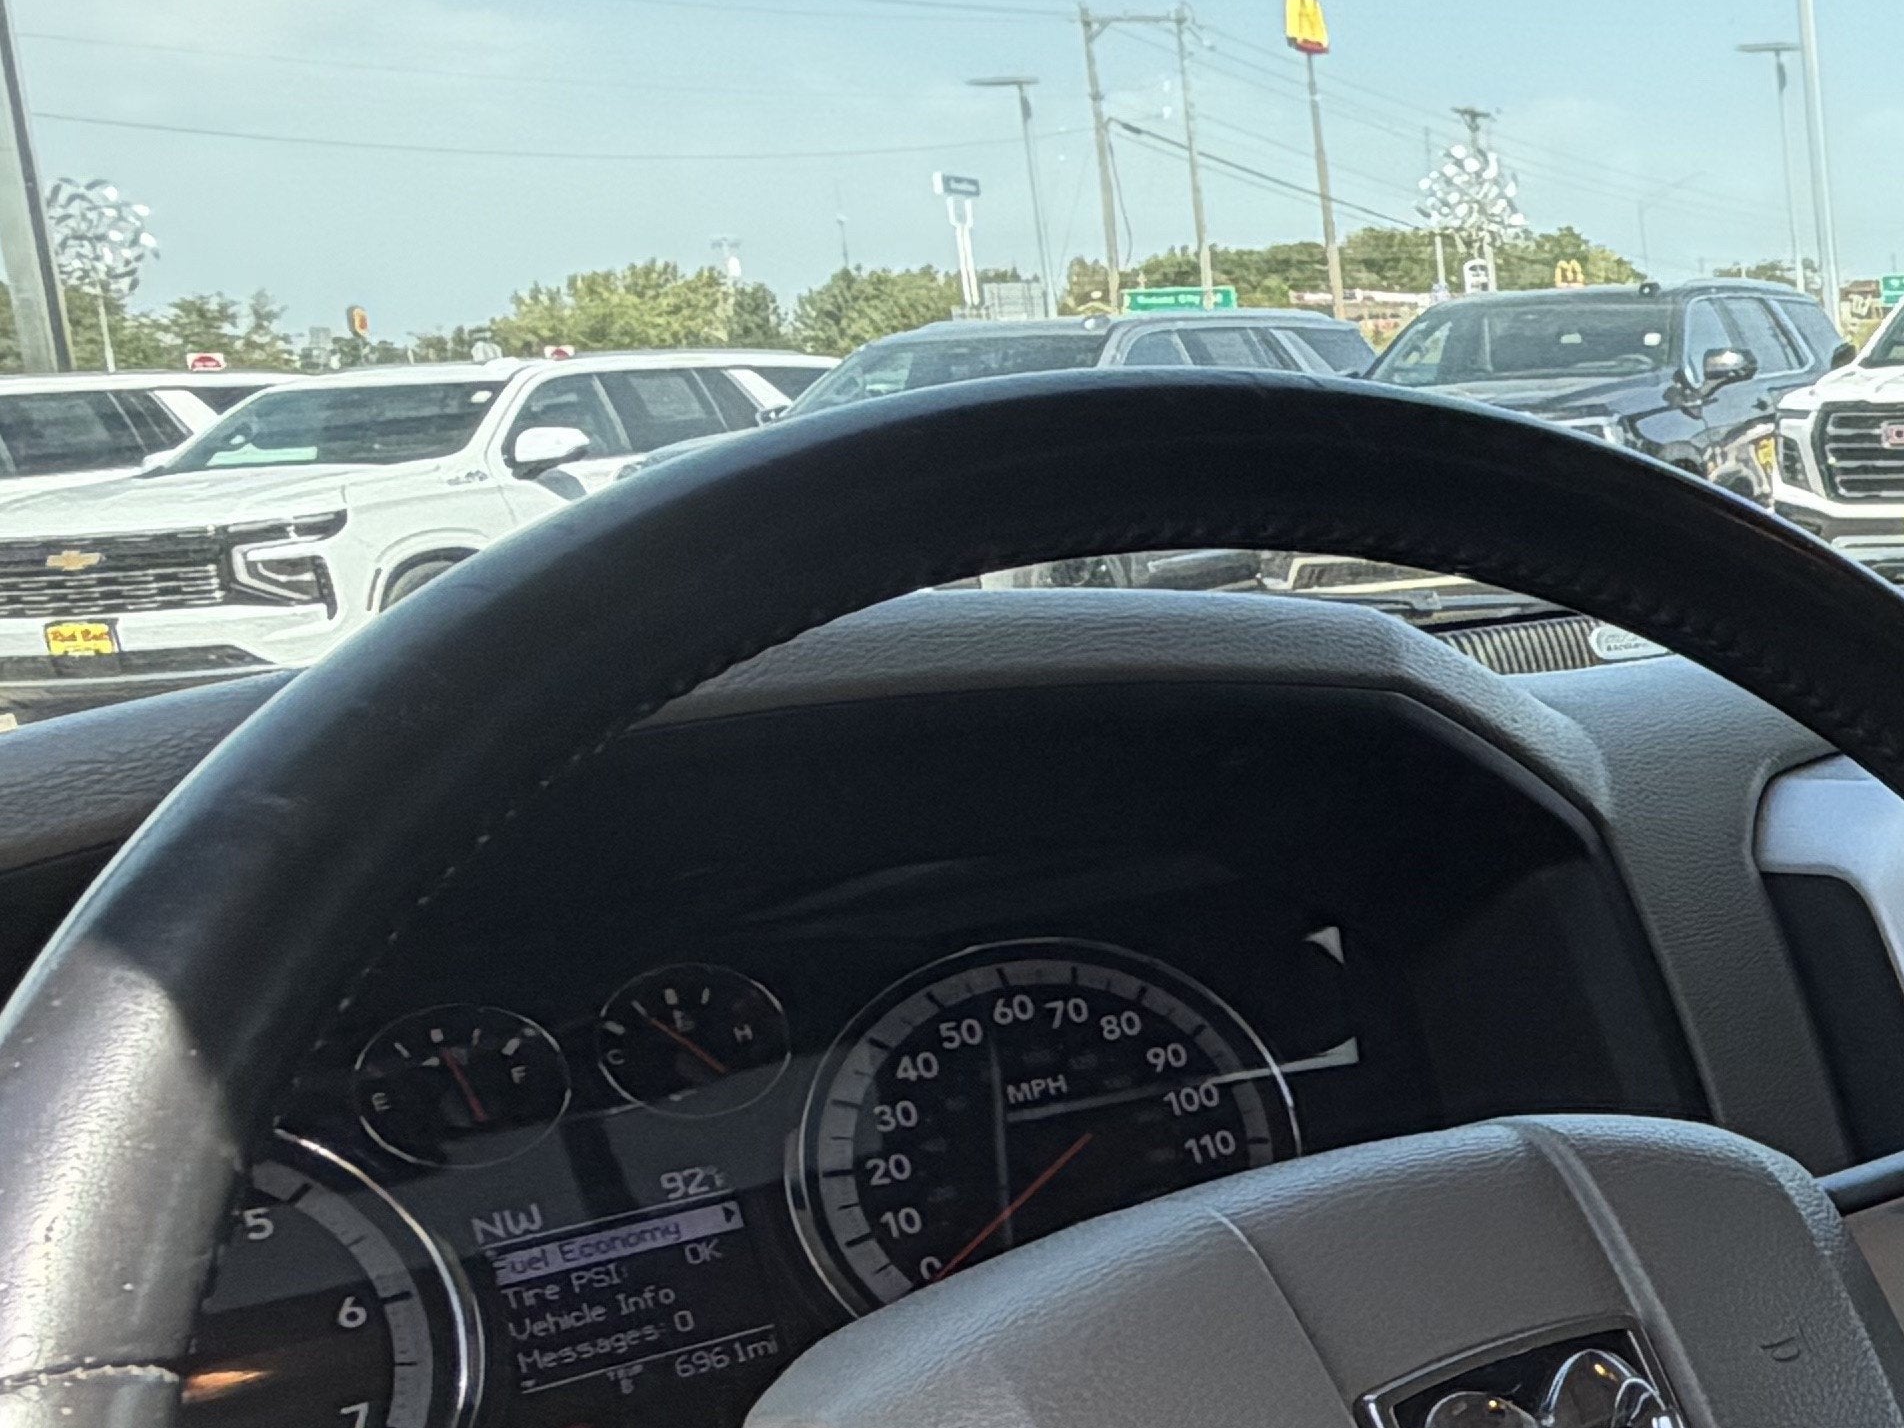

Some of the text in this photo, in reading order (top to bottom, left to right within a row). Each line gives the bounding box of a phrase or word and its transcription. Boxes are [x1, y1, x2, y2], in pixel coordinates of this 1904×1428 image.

[992, 993, 1036, 1026] 60
[1042, 996, 1090, 1031] 70
[1099, 1009, 1143, 1042] 80
[732, 1023, 754, 1044] H
[937, 1017, 984, 1051] 50
[510, 1065, 527, 1085] F
[895, 1050, 941, 1084] 40
[1145, 1041, 1189, 1074] 90
[370, 1091, 390, 1113] E
[1005, 1073, 1069, 1105] MPH
[1162, 1082, 1221, 1117] 100
[872, 1098, 919, 1134] 30
[1183, 1128, 1237, 1166] 110
[864, 1152, 913, 1187] 20
[242, 1206, 275, 1241] 5
[471, 1203, 544, 1246] NW
[879, 1205, 923, 1240] 10
[557, 1221, 683, 1264] Economy
[501, 1283, 562, 1310] Tire
[683, 1237, 722, 1267] OK
[336, 1295, 368, 1329] 6
[507, 1283, 677, 1342] Vehicle Info
